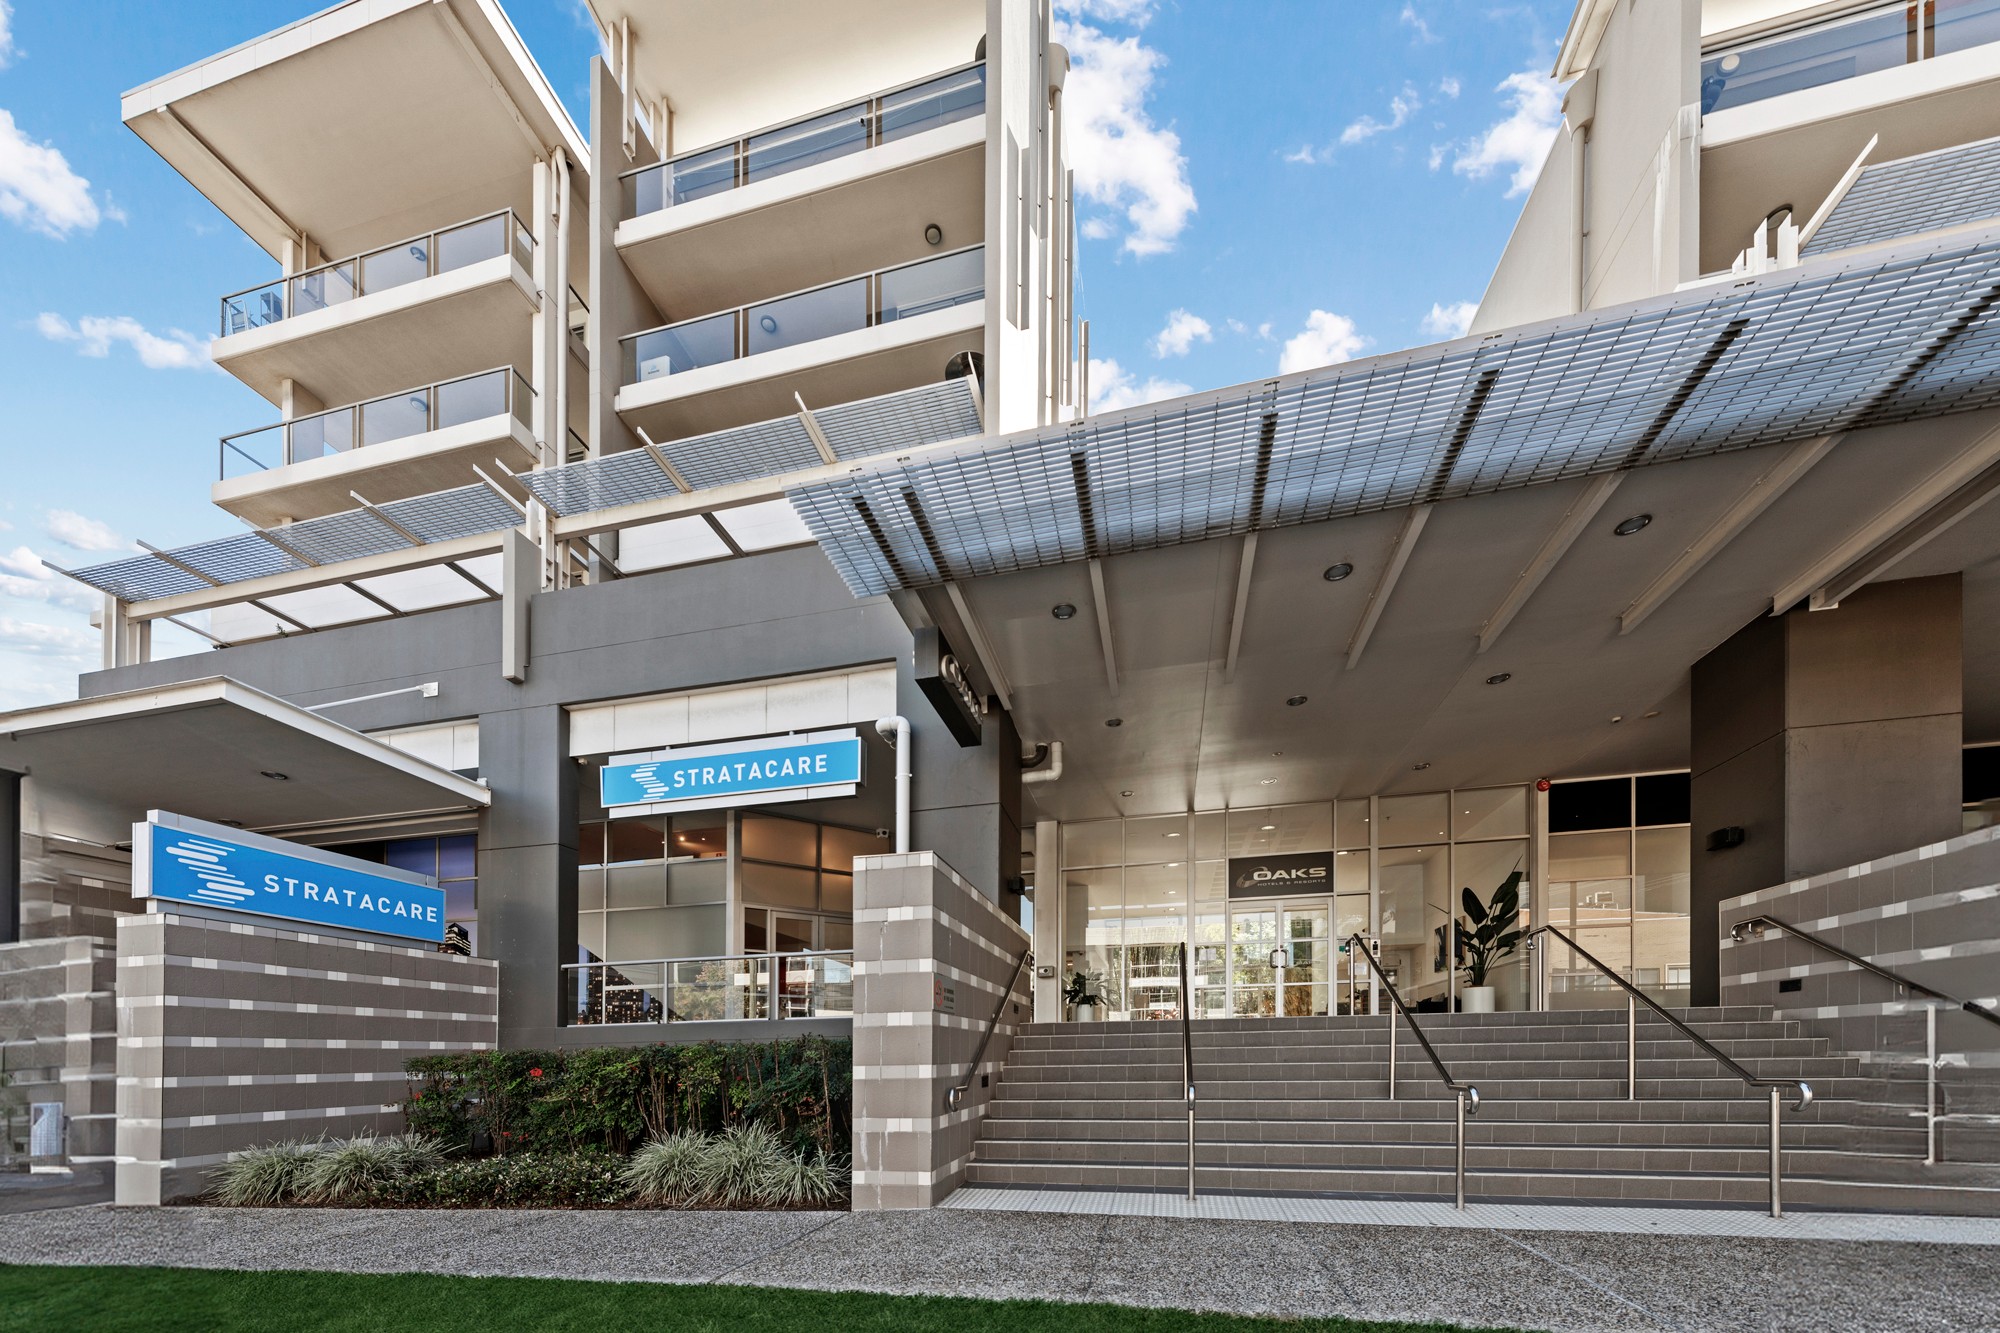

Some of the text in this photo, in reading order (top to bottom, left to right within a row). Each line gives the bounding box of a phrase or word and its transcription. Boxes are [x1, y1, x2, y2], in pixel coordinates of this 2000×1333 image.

[673, 754, 827, 788] STRATACARE
[1253, 867, 1327, 881] OAKS
[264, 874, 437, 922] STRATACARE
